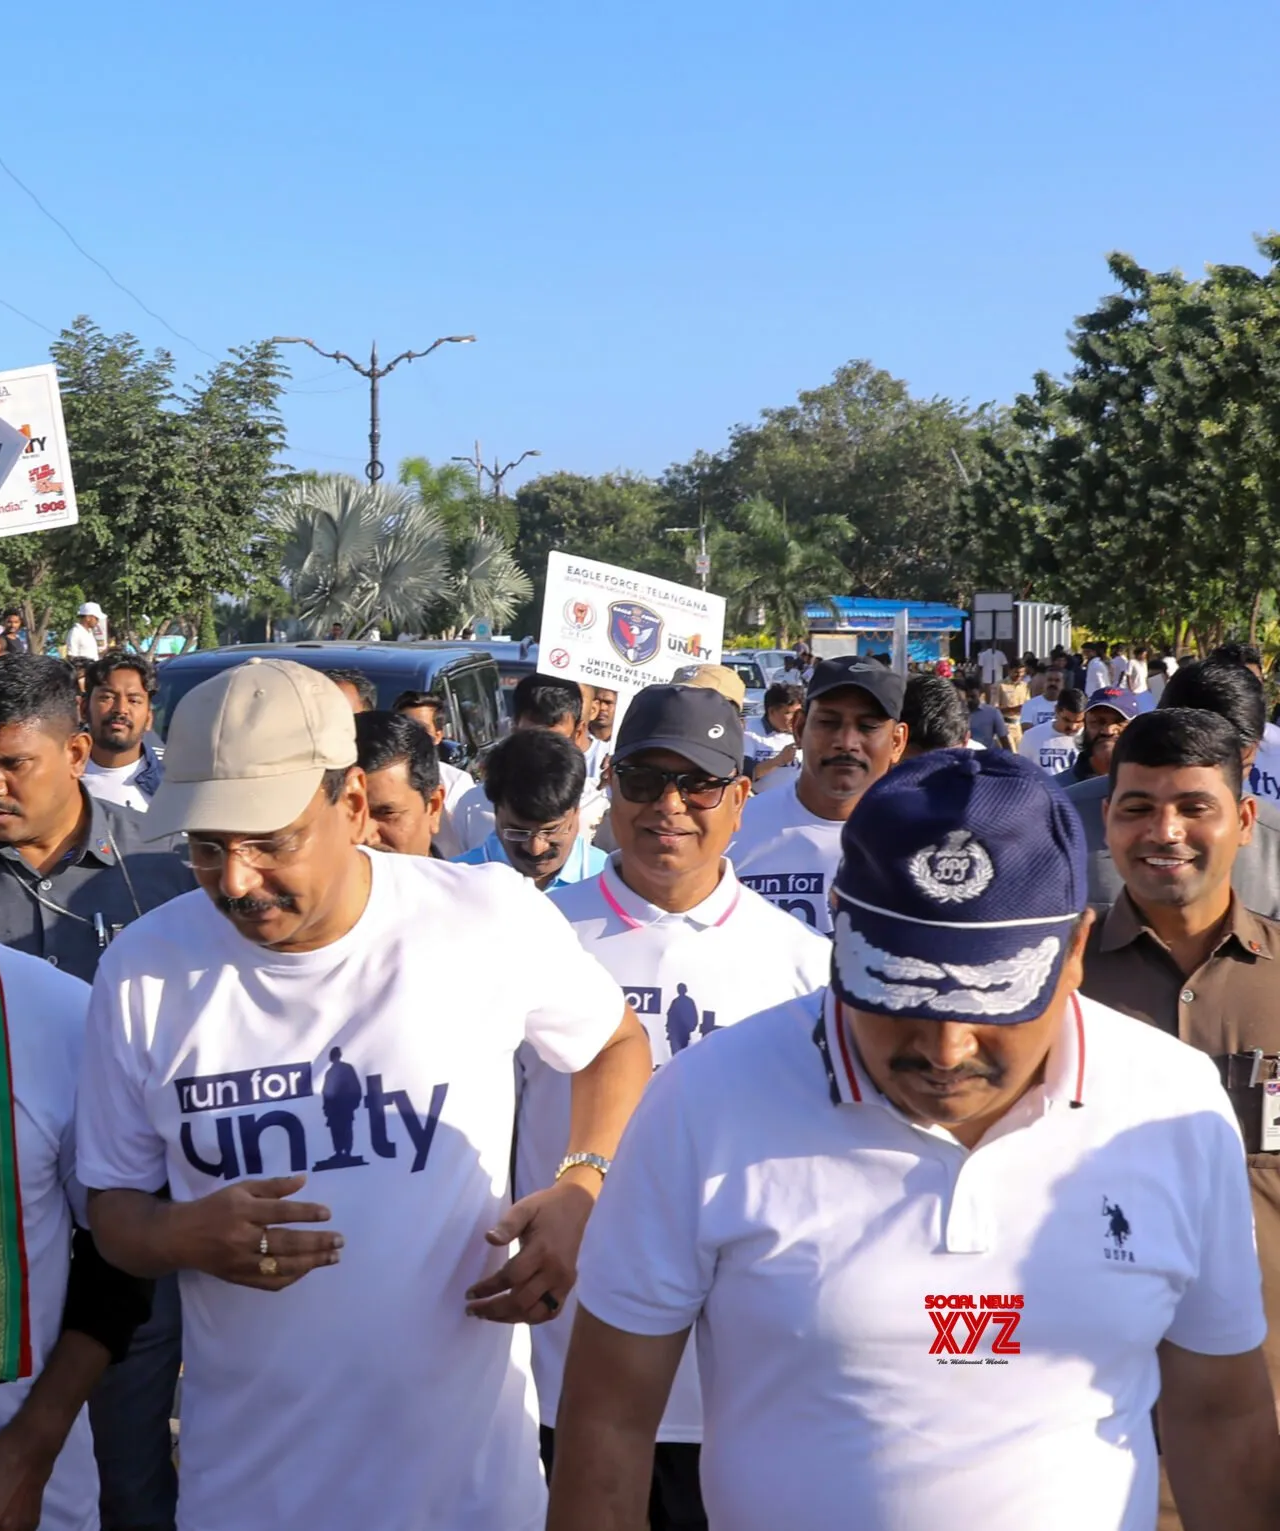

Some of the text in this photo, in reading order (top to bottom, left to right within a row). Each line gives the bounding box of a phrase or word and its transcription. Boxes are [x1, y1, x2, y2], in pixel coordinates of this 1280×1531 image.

[35, 500, 67, 514] 1908
[567, 565, 601, 582] EAGLE
[604, 575, 638, 591] FORCE
[646, 587, 709, 612] TELANGANA
[580, 665, 646, 688] TOGETHER WE
[587, 658, 621, 672] UNITED
[624, 667, 638, 677] WE
[787, 874, 818, 892] for
[624, 992, 654, 1011] or
[182, 1069, 302, 1110] run for
[1103, 1248, 1136, 1263] USPA
